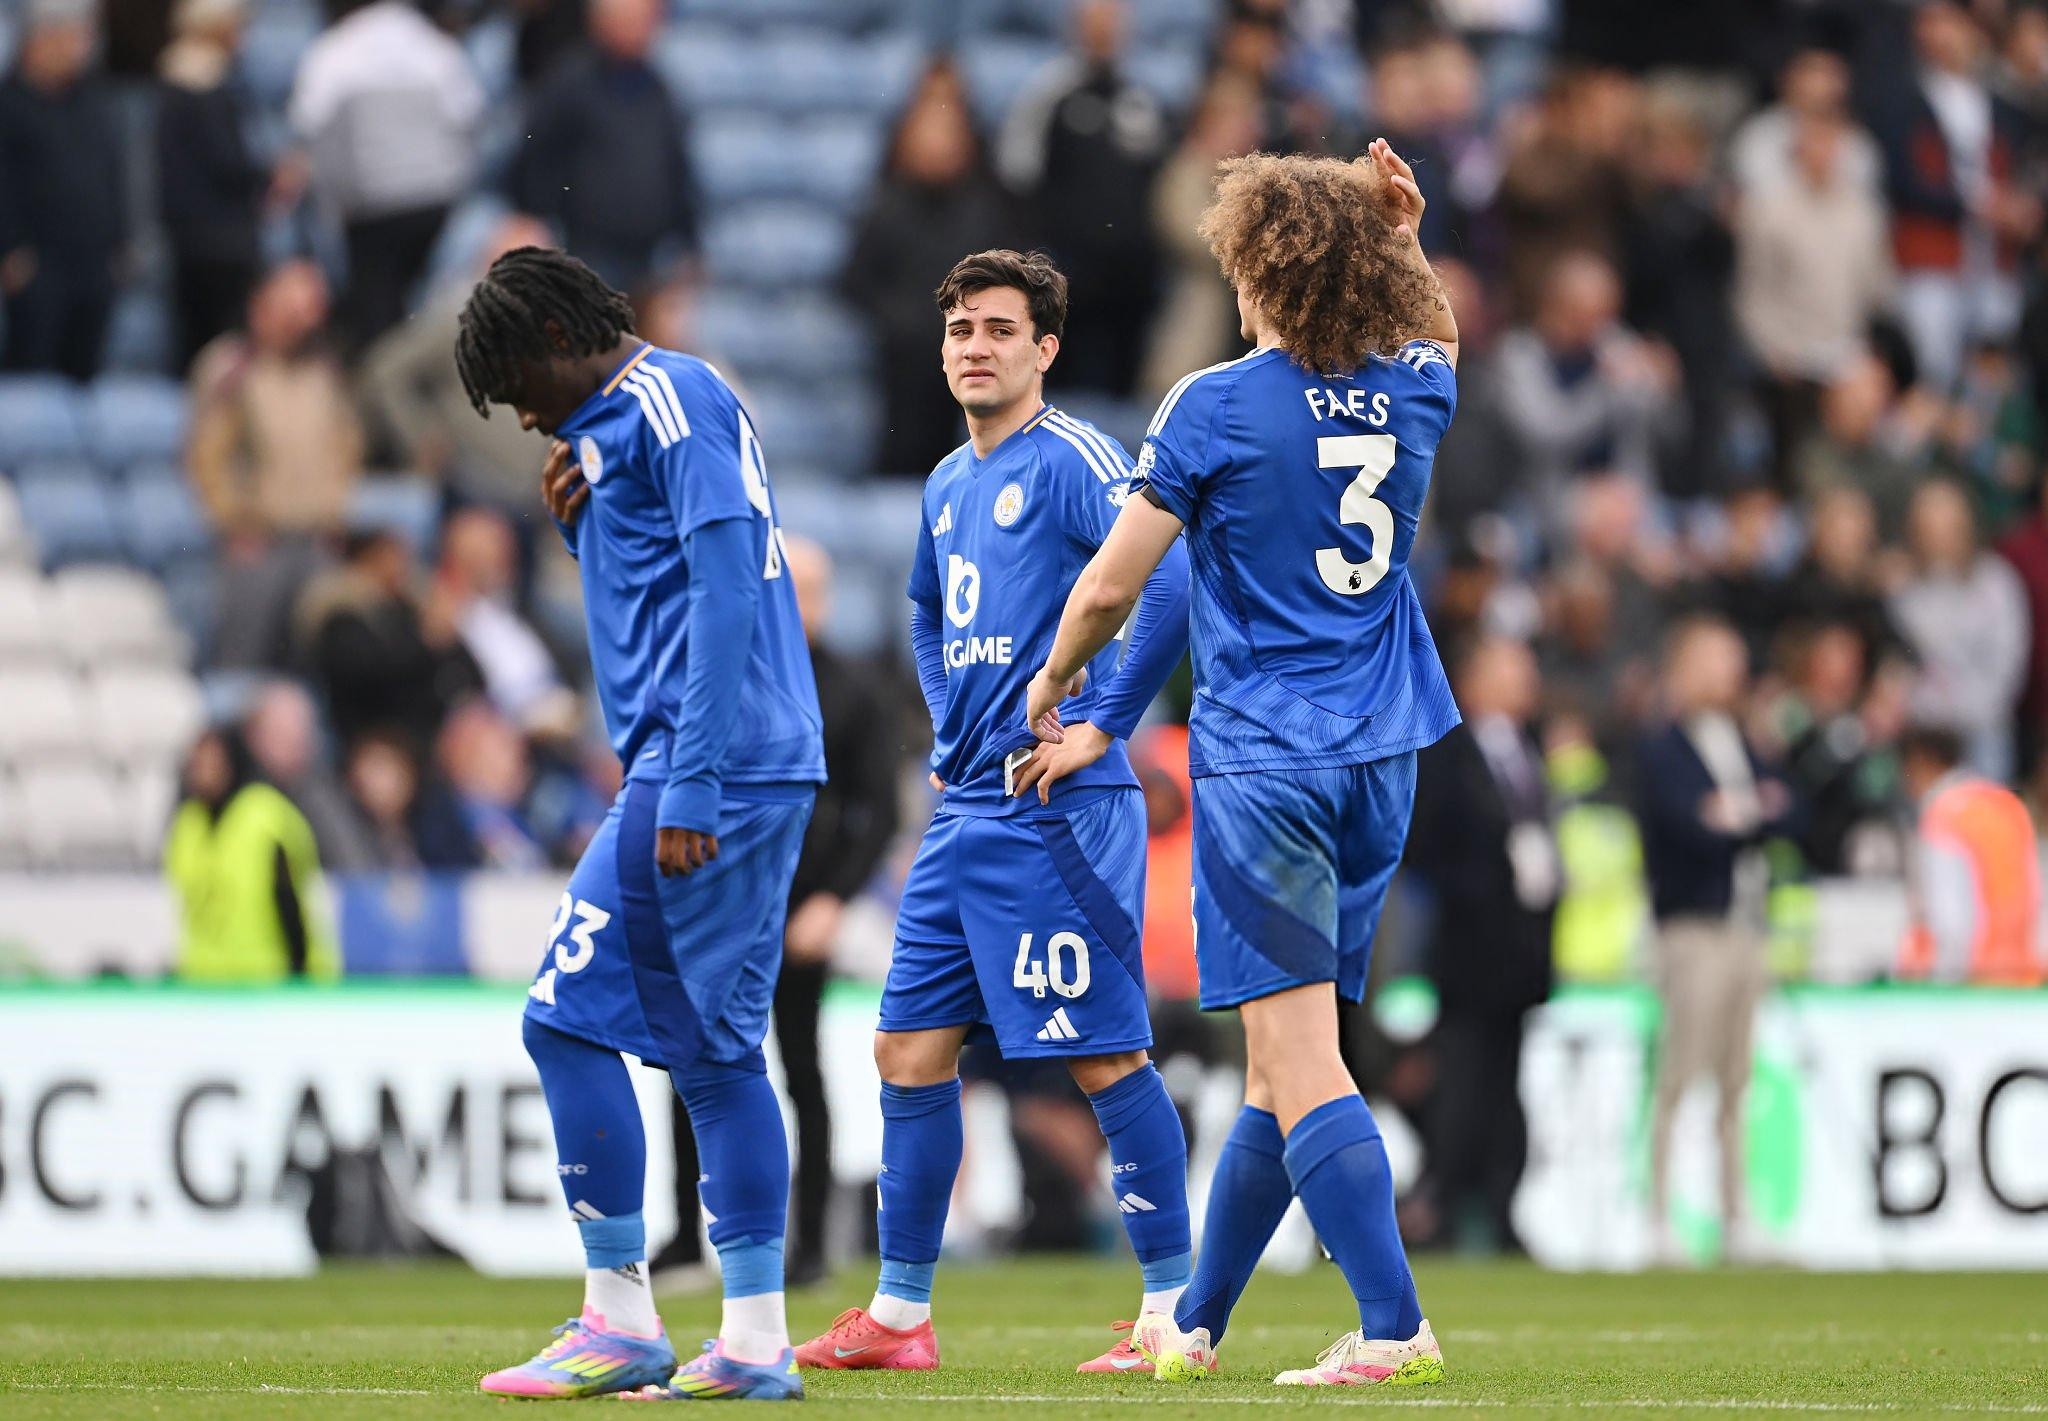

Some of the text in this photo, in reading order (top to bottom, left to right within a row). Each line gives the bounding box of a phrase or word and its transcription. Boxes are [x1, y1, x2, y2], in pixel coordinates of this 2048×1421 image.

[1304, 387, 1390, 427] FAES
[1315, 434, 1397, 595] 3
[1014, 931, 1091, 998] 40
[0, 1078, 550, 1212] C.GAME
